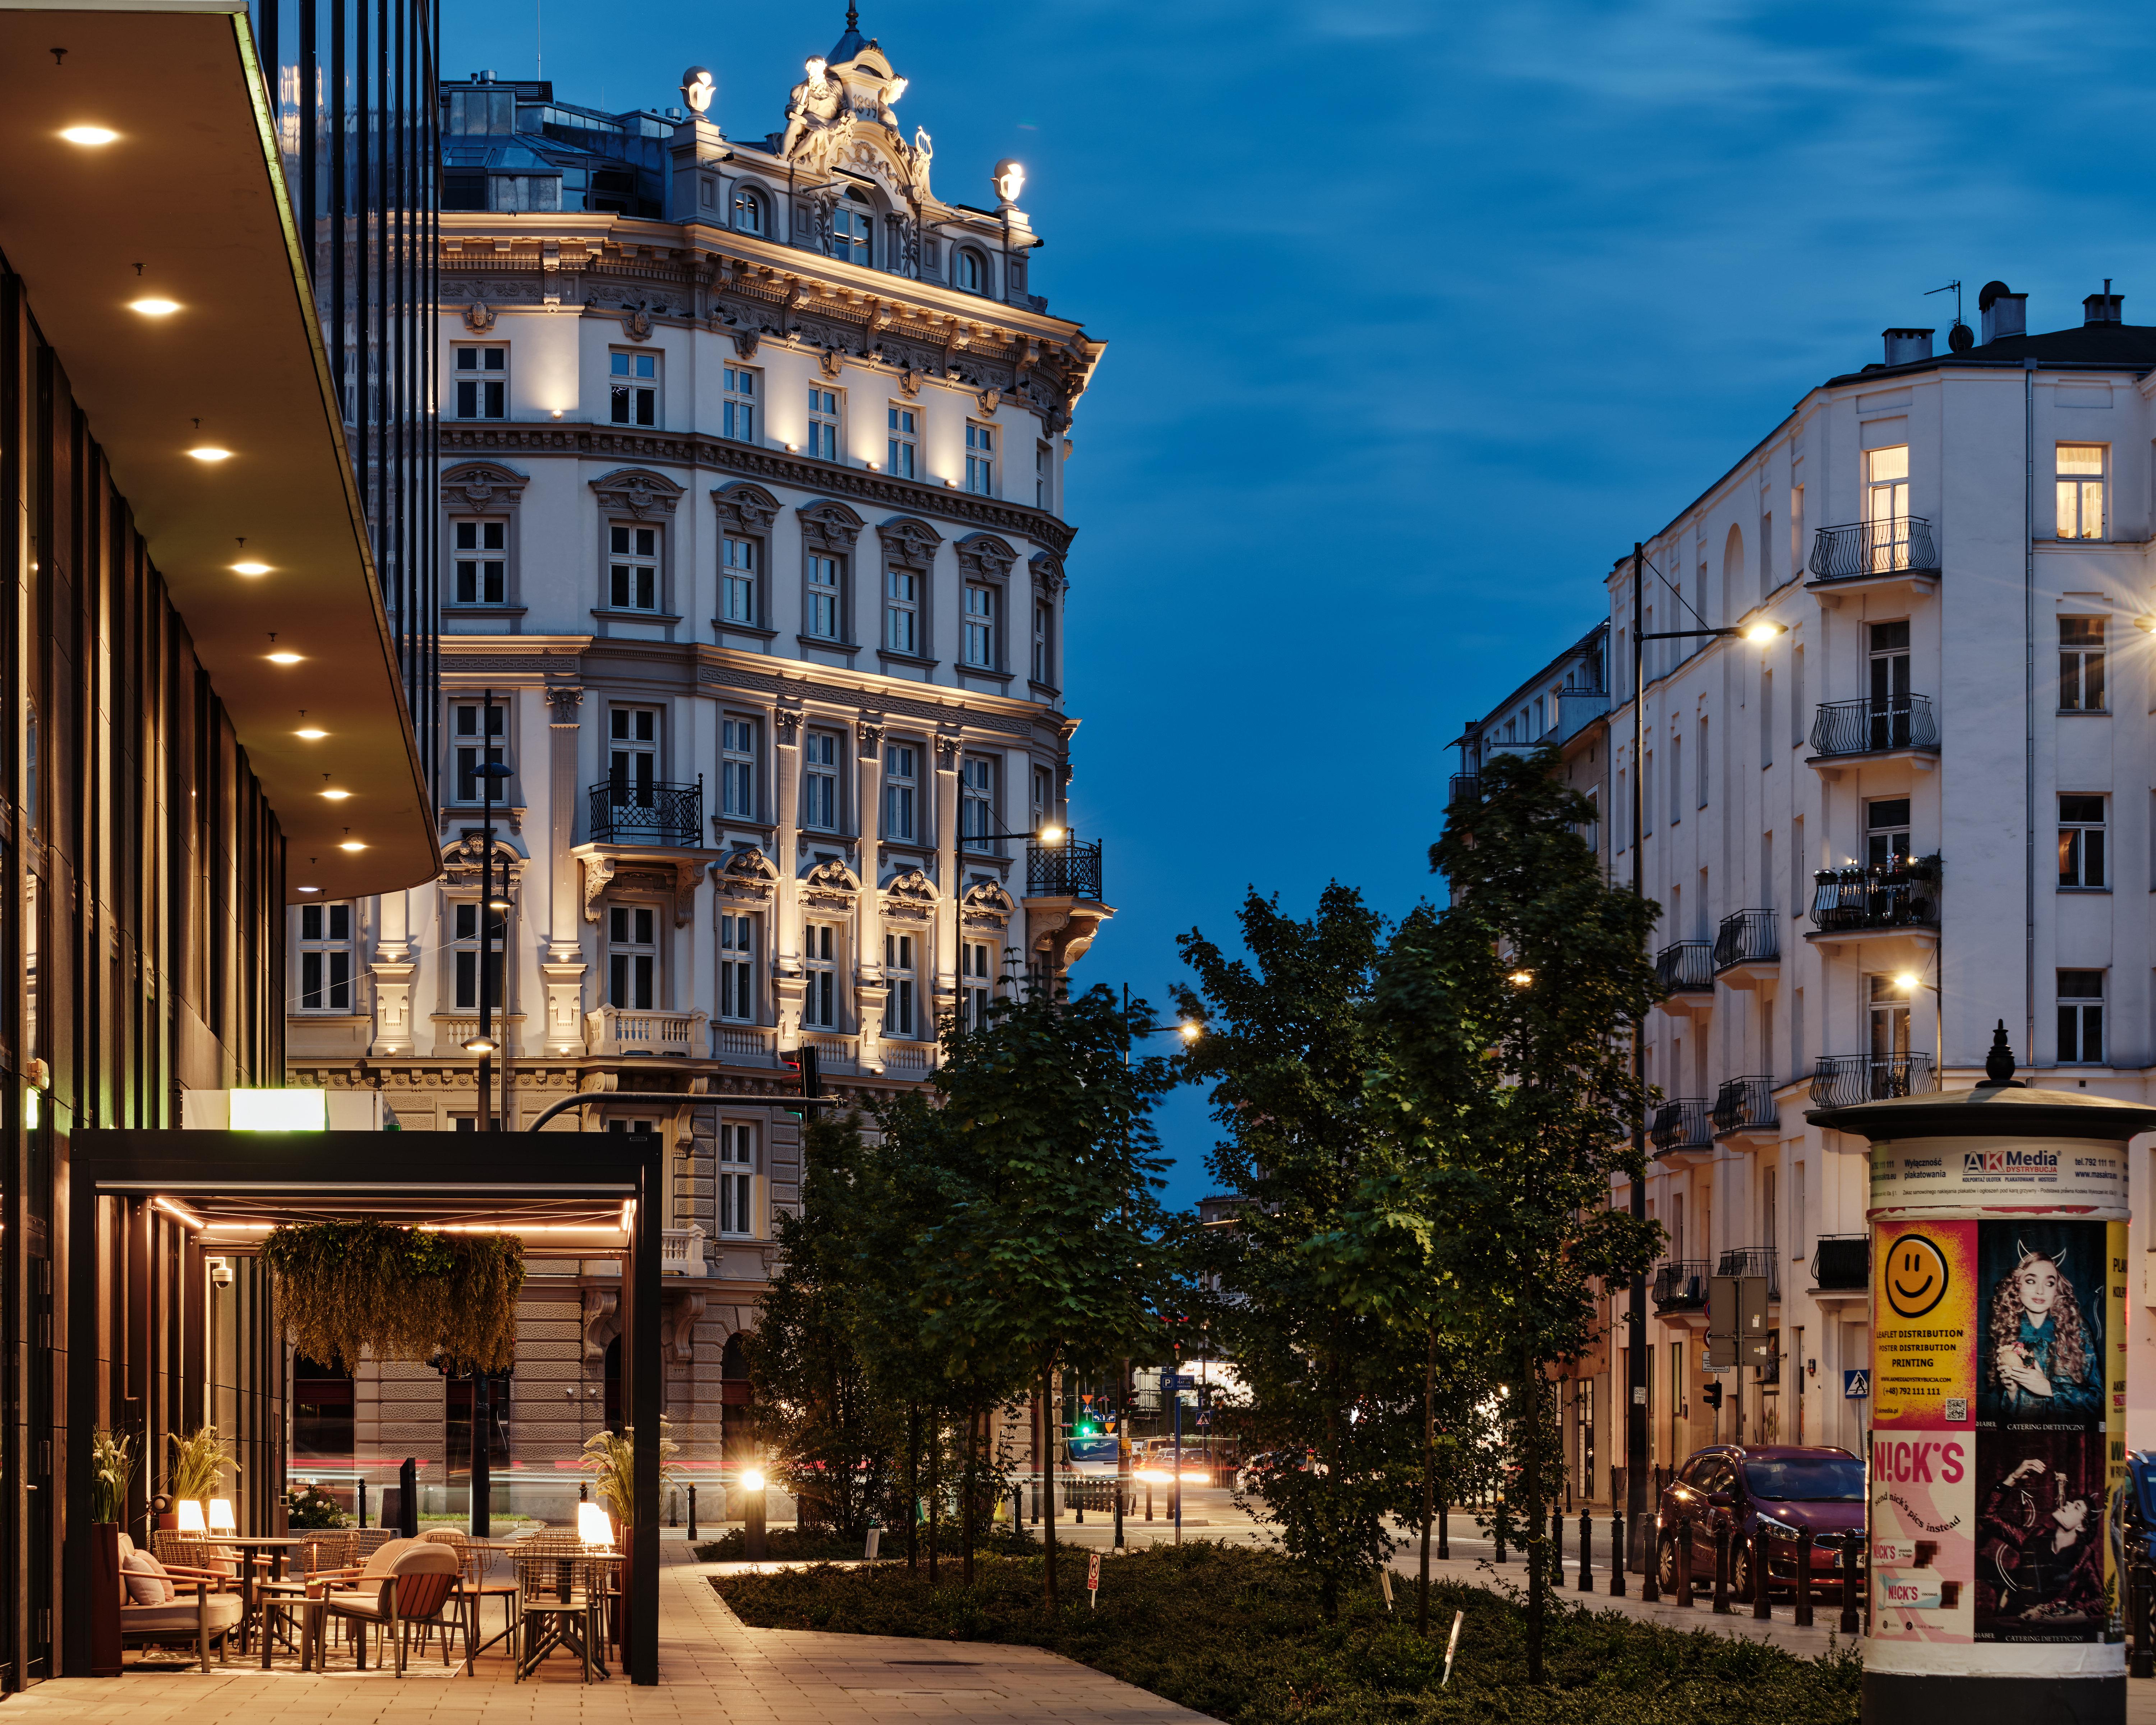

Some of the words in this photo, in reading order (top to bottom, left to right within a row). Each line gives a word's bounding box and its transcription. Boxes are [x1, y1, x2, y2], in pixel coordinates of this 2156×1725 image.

[853, 94, 877, 118] 1899
[1904, 1158, 1942, 1168] Wyłączność
[1963, 1151, 2005, 1173] AK
[2075, 1158, 2096, 1166] tel.792
[1904, 1170, 1946, 1180] plakatowania
[1892, 1358, 1934, 1367] PRINTING
[1883, 1387, 1898, 1396] (+48)
[1875, 1492, 1888, 1506] send
[1889, 1494, 1909, 1511] nick's
[1907, 1510, 1924, 1528] pics
[1926, 1515, 1961, 1532] instead
